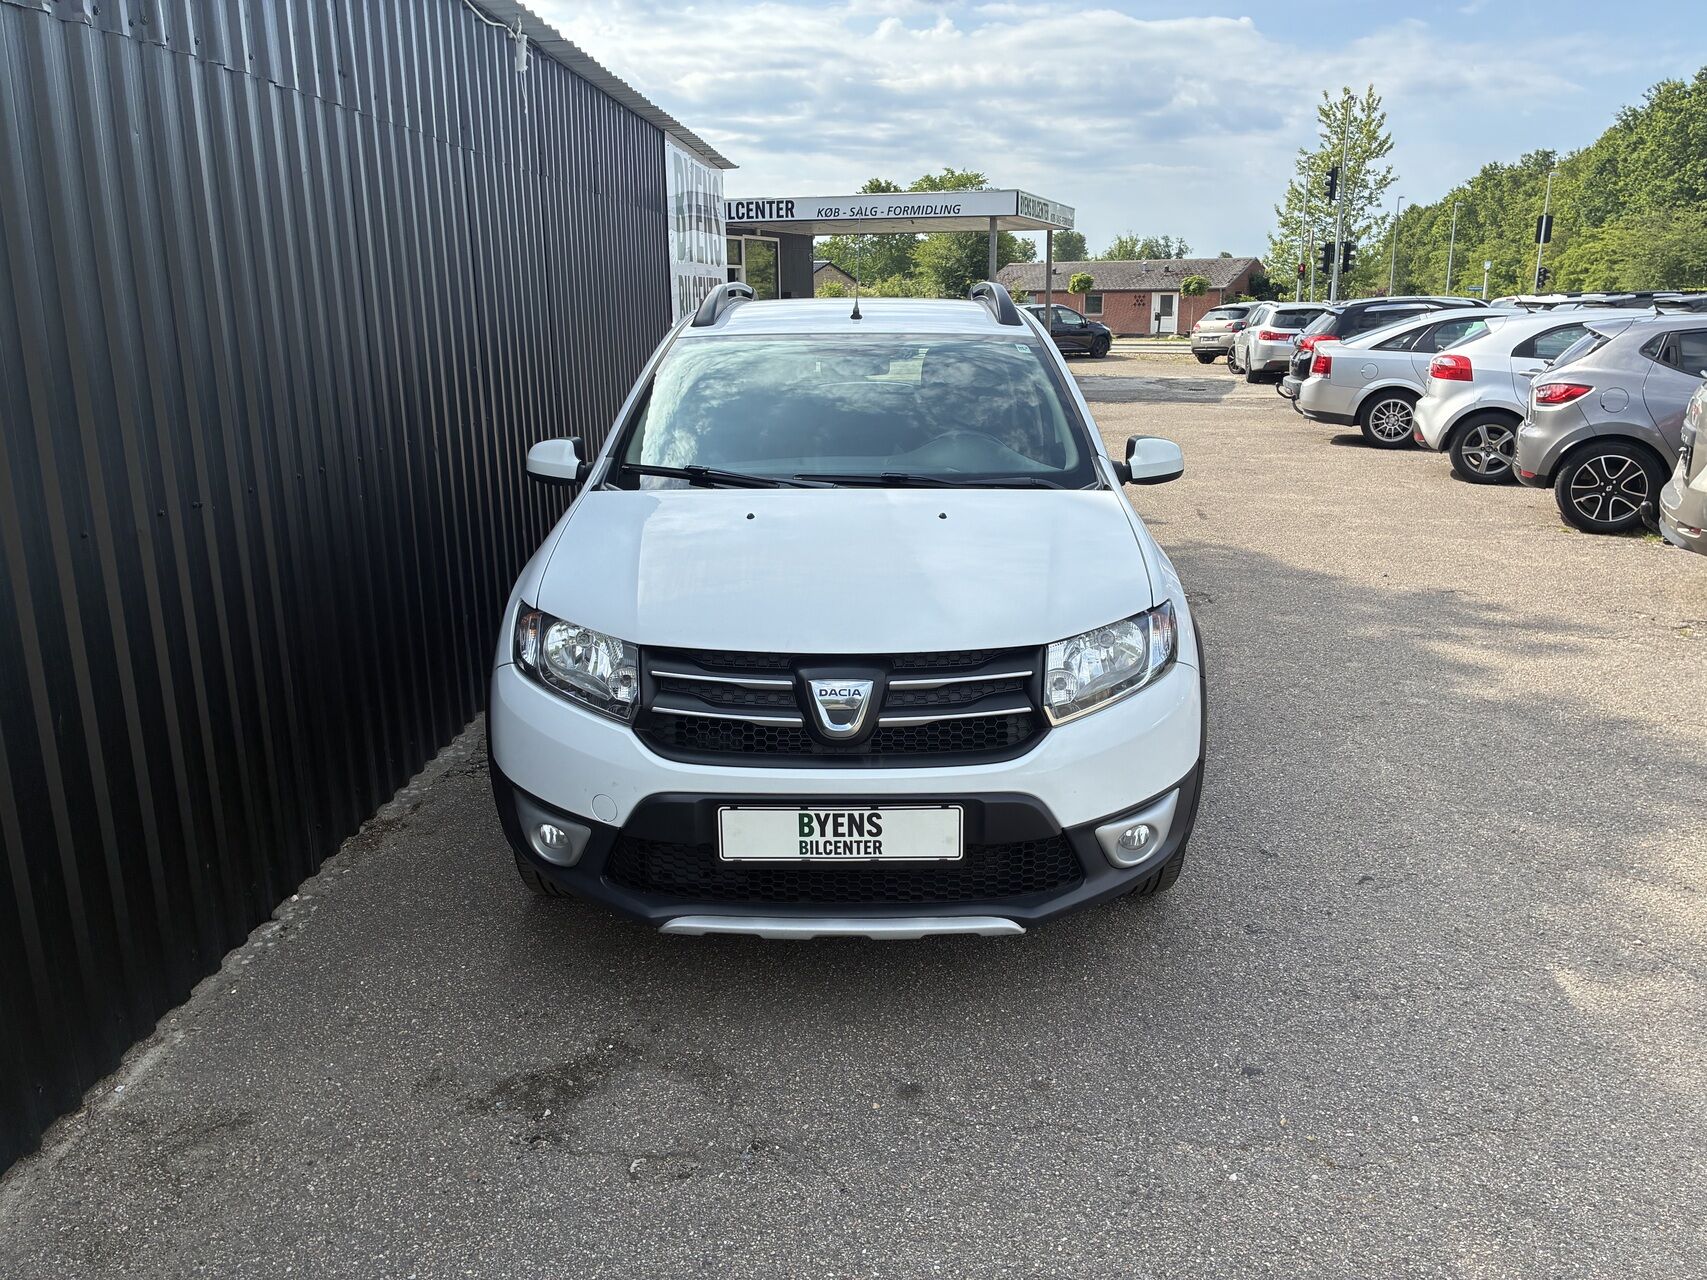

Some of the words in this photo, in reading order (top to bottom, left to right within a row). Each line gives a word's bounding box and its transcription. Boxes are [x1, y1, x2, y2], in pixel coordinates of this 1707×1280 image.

[673, 152, 722, 268] BYENS
[816, 207, 840, 218] KØB
[849, 206, 878, 217] SALG
[887, 204, 961, 216] FORMIDLING
[818, 688, 862, 697] DACIA
[798, 812, 883, 838] BYENS
[799, 839, 883, 856] BILCENTER
